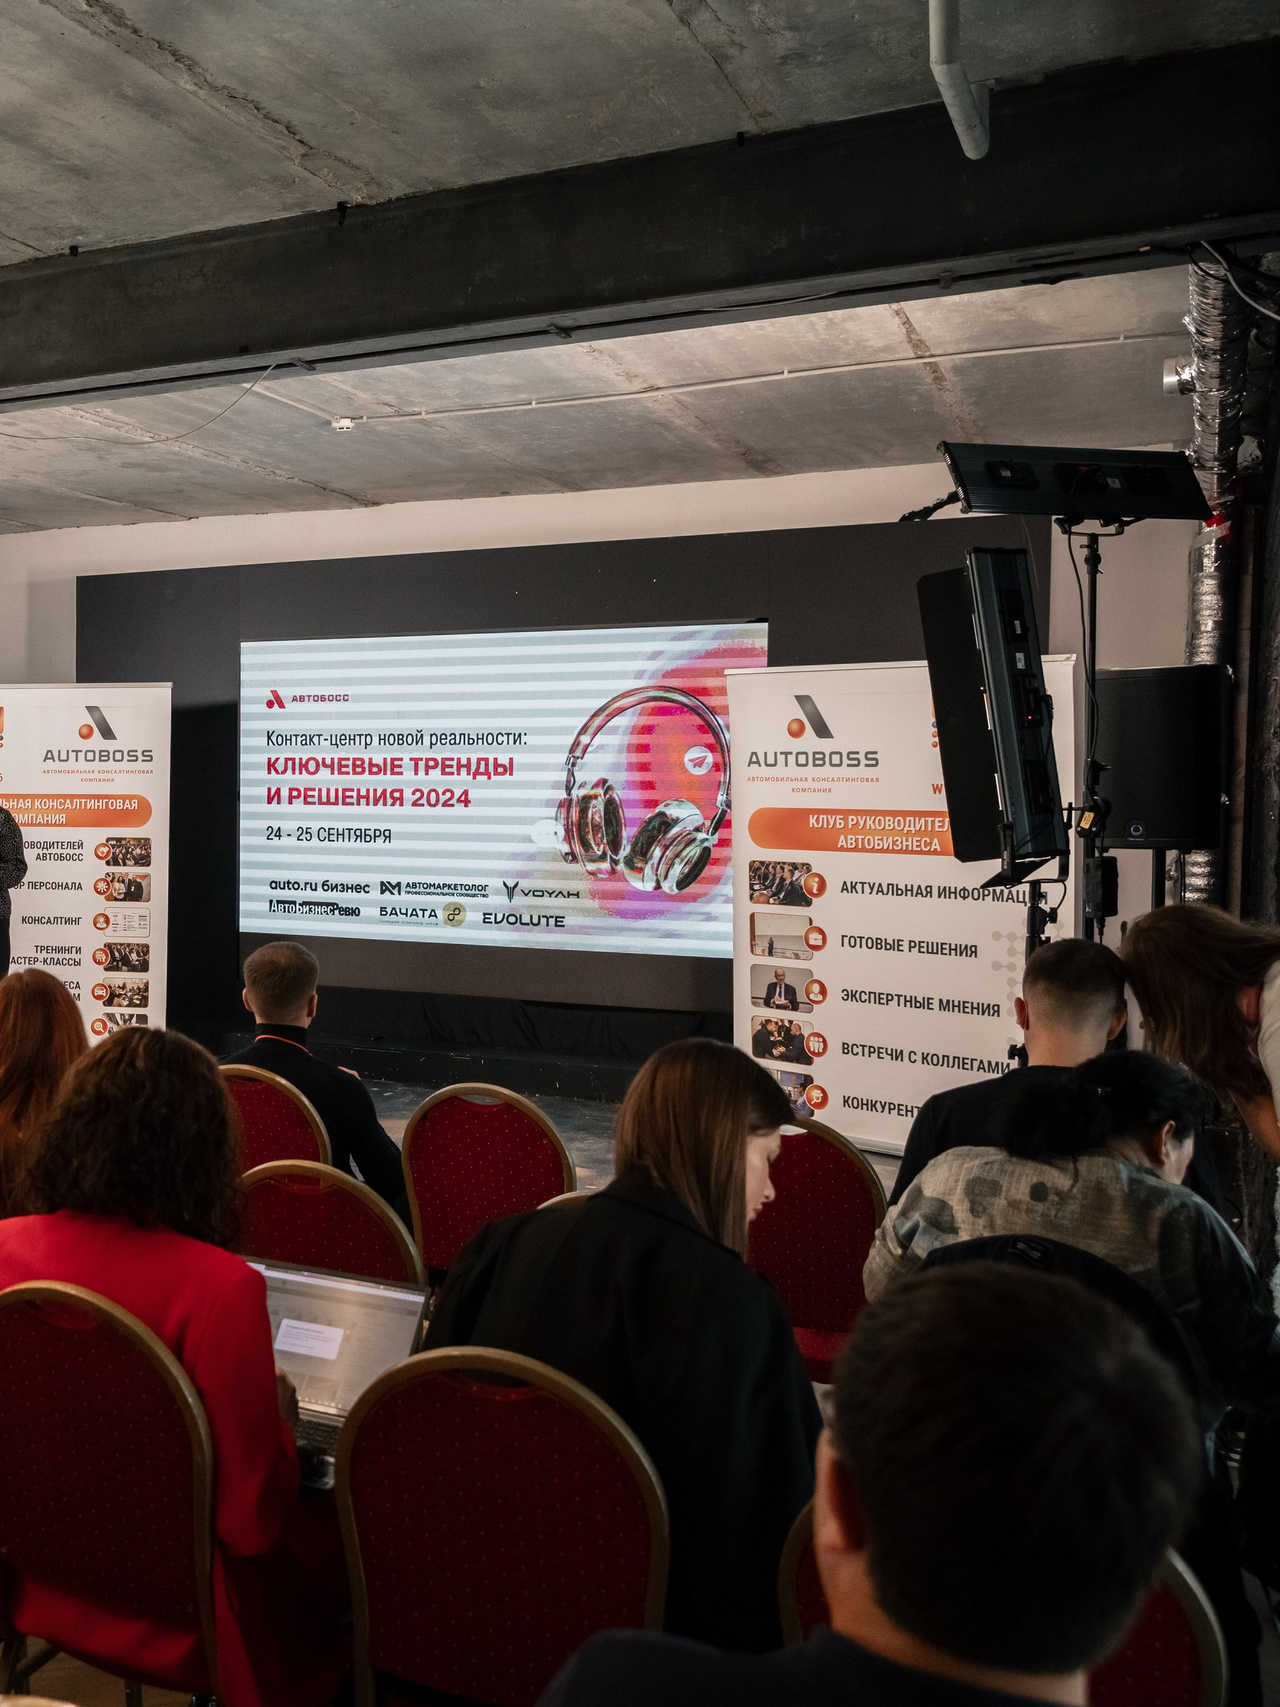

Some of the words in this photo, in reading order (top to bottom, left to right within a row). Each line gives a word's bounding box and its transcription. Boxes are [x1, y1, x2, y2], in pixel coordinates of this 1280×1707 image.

[292, 694, 350, 703] АВТОБОСС
[266, 730, 373, 749] Контакт-центр
[378, 729, 424, 746] новой
[429, 731, 528, 749] реальности:
[43, 749, 154, 762] AUTOBOSS
[747, 751, 880, 768] AUTOBOSS
[266, 756, 403, 776] КЛЮЧЕВЫЕ
[410, 757, 514, 780] ТРЕНДЫ
[34, 798, 138, 810] КОНСАЛТИНГОВАЯ
[267, 787, 280, 804] И
[288, 787, 404, 807] РЕШЕНИЯ
[411, 788, 471, 808] 2024
[12, 813, 66, 825] ОМПАНИЯ
[809, 814, 844, 828] КЛУБ
[266, 826, 282, 841] 24
[296, 826, 312, 842] 25
[317, 827, 392, 844] СЕНТЯБРЯ
[838, 834, 941, 852] АВТОБИЗНЕСА
[36, 852, 84, 862] АВТОБОСС
[28, 881, 83, 890] ПЕРСОНАЛА
[270, 878, 318, 892] auto.ru
[321, 879, 370, 894] бизнес
[404, 882, 489, 892] АВТОМАРКЕТОЛОГ
[840, 880, 933, 898] АКТУАЛЬНАЯ
[520, 889, 580, 898] VOYAH
[380, 906, 438, 919] БАЧАТА
[22, 916, 82, 926] КОНСАЛТИНГ
[482, 912, 566, 928] EVOLUTE
[34, 944, 82, 954] ТРЕНИНГИ
[841, 934, 904, 952] ГОТОВЫЕ
[908, 940, 978, 958] РЕШЕНИЯ
[10, 956, 82, 966] АСТЕР-КЛАССЫ
[841, 988, 934, 1010] ЭКСПЕРТНЫЕ
[938, 998, 1000, 1018] МНЕНИЯ
[842, 1042, 904, 1062] ВСТРЕЧИ
[908, 1050, 917, 1064] С
[921, 1052, 1010, 1075] КОЛЛЕГАМИ
